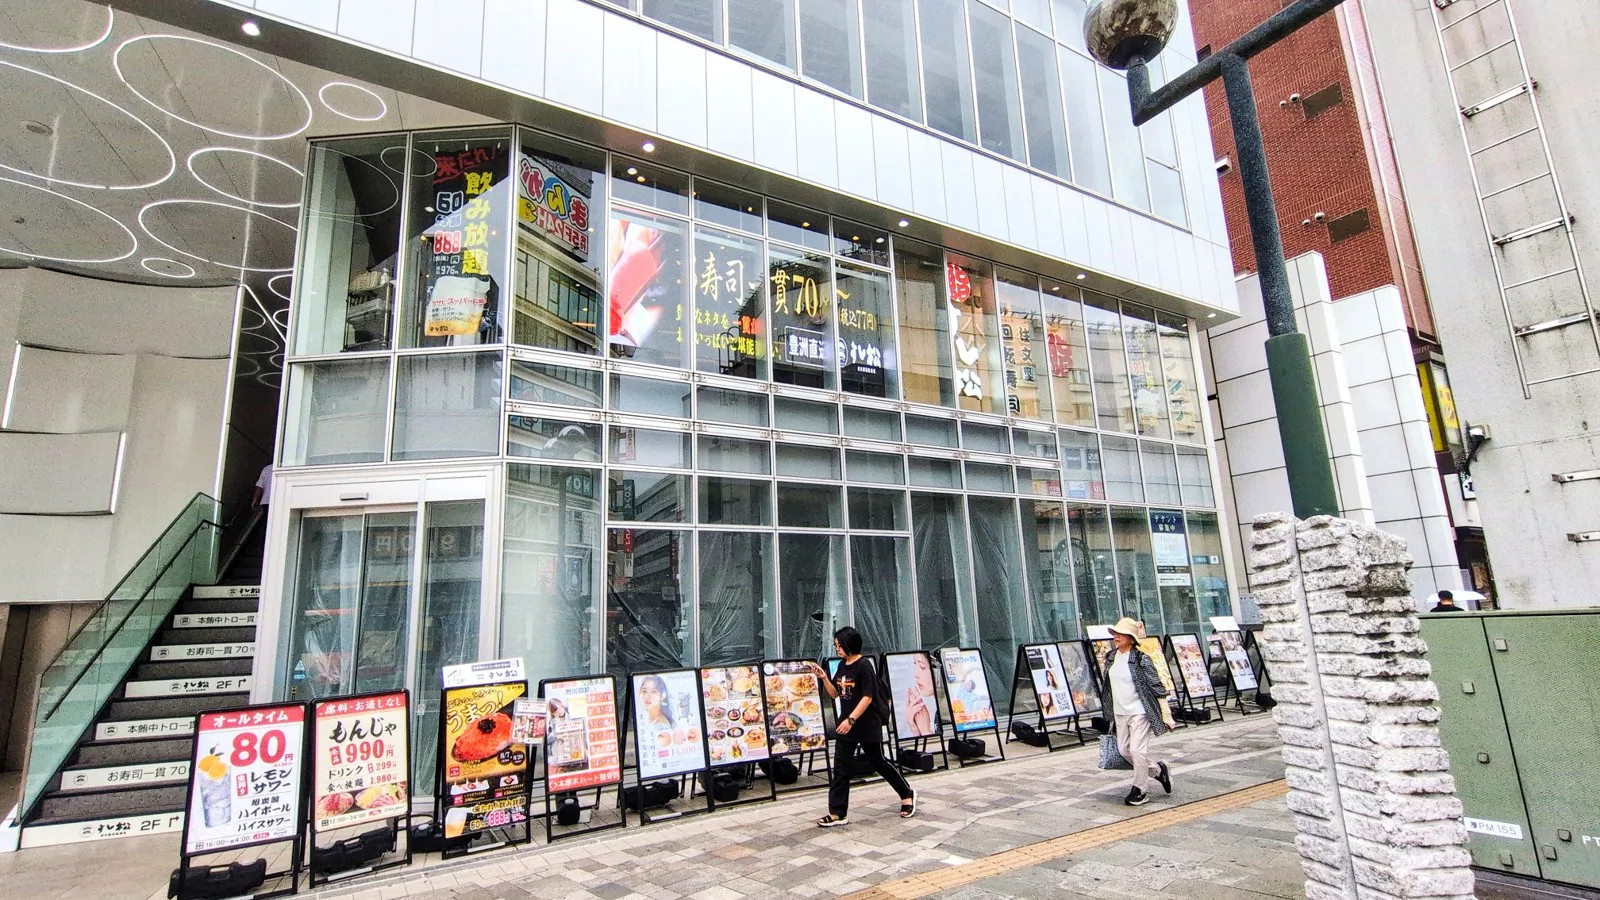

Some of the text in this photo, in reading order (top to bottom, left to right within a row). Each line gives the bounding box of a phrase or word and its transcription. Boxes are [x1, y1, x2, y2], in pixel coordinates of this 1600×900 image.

[436, 190, 464, 214] 60
[463, 171, 493, 275] 飲み放題
[700, 251, 744, 306] 寿司
[187, 646, 232, 656] お寿司一貫
[216, 680, 232, 689] 2F
[213, 710, 289, 728] オールタイム
[447, 690, 504, 733] うまっ!
[329, 717, 397, 743] もんじゃ
[108, 765, 187, 782] お寿司一貫 70
[251, 767, 293, 782] レモン
[328, 765, 364, 780] ドリンク
[253, 780, 291, 795] サワー
[326, 779, 364, 793] 食べ放題
[238, 803, 291, 819] ハイボール
[140, 819, 161, 831] 2F
[1478, 823, 1517, 835] PM 155
